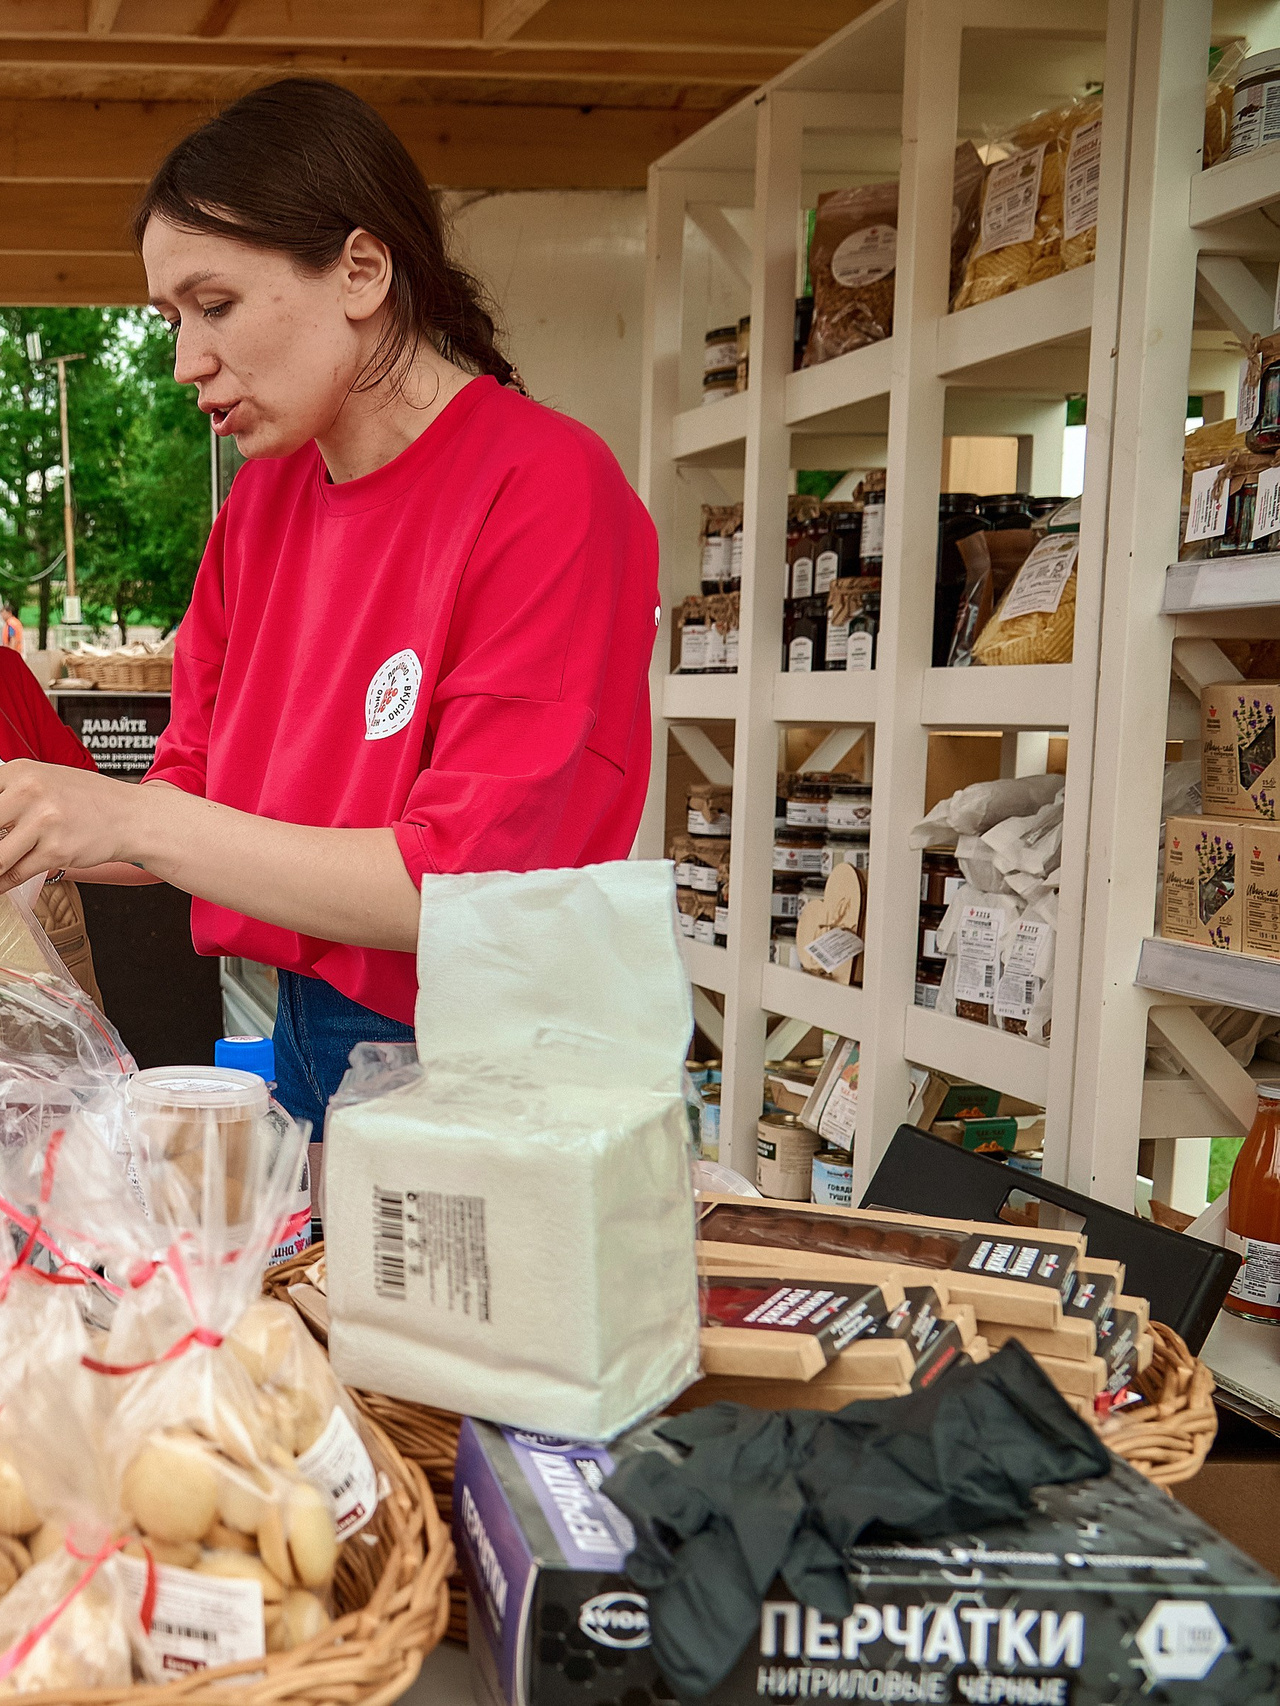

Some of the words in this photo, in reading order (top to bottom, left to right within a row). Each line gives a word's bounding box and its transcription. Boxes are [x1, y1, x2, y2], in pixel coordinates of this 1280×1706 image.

[388, 685, 412, 721] ВКУСНО
[81, 715, 147, 734] ДАВАЙТЕ
[759, 1601, 1085, 1668] ПЕРЧАТКИ
[756, 1663, 949, 1703] НИТРИЛОВЫЕ
